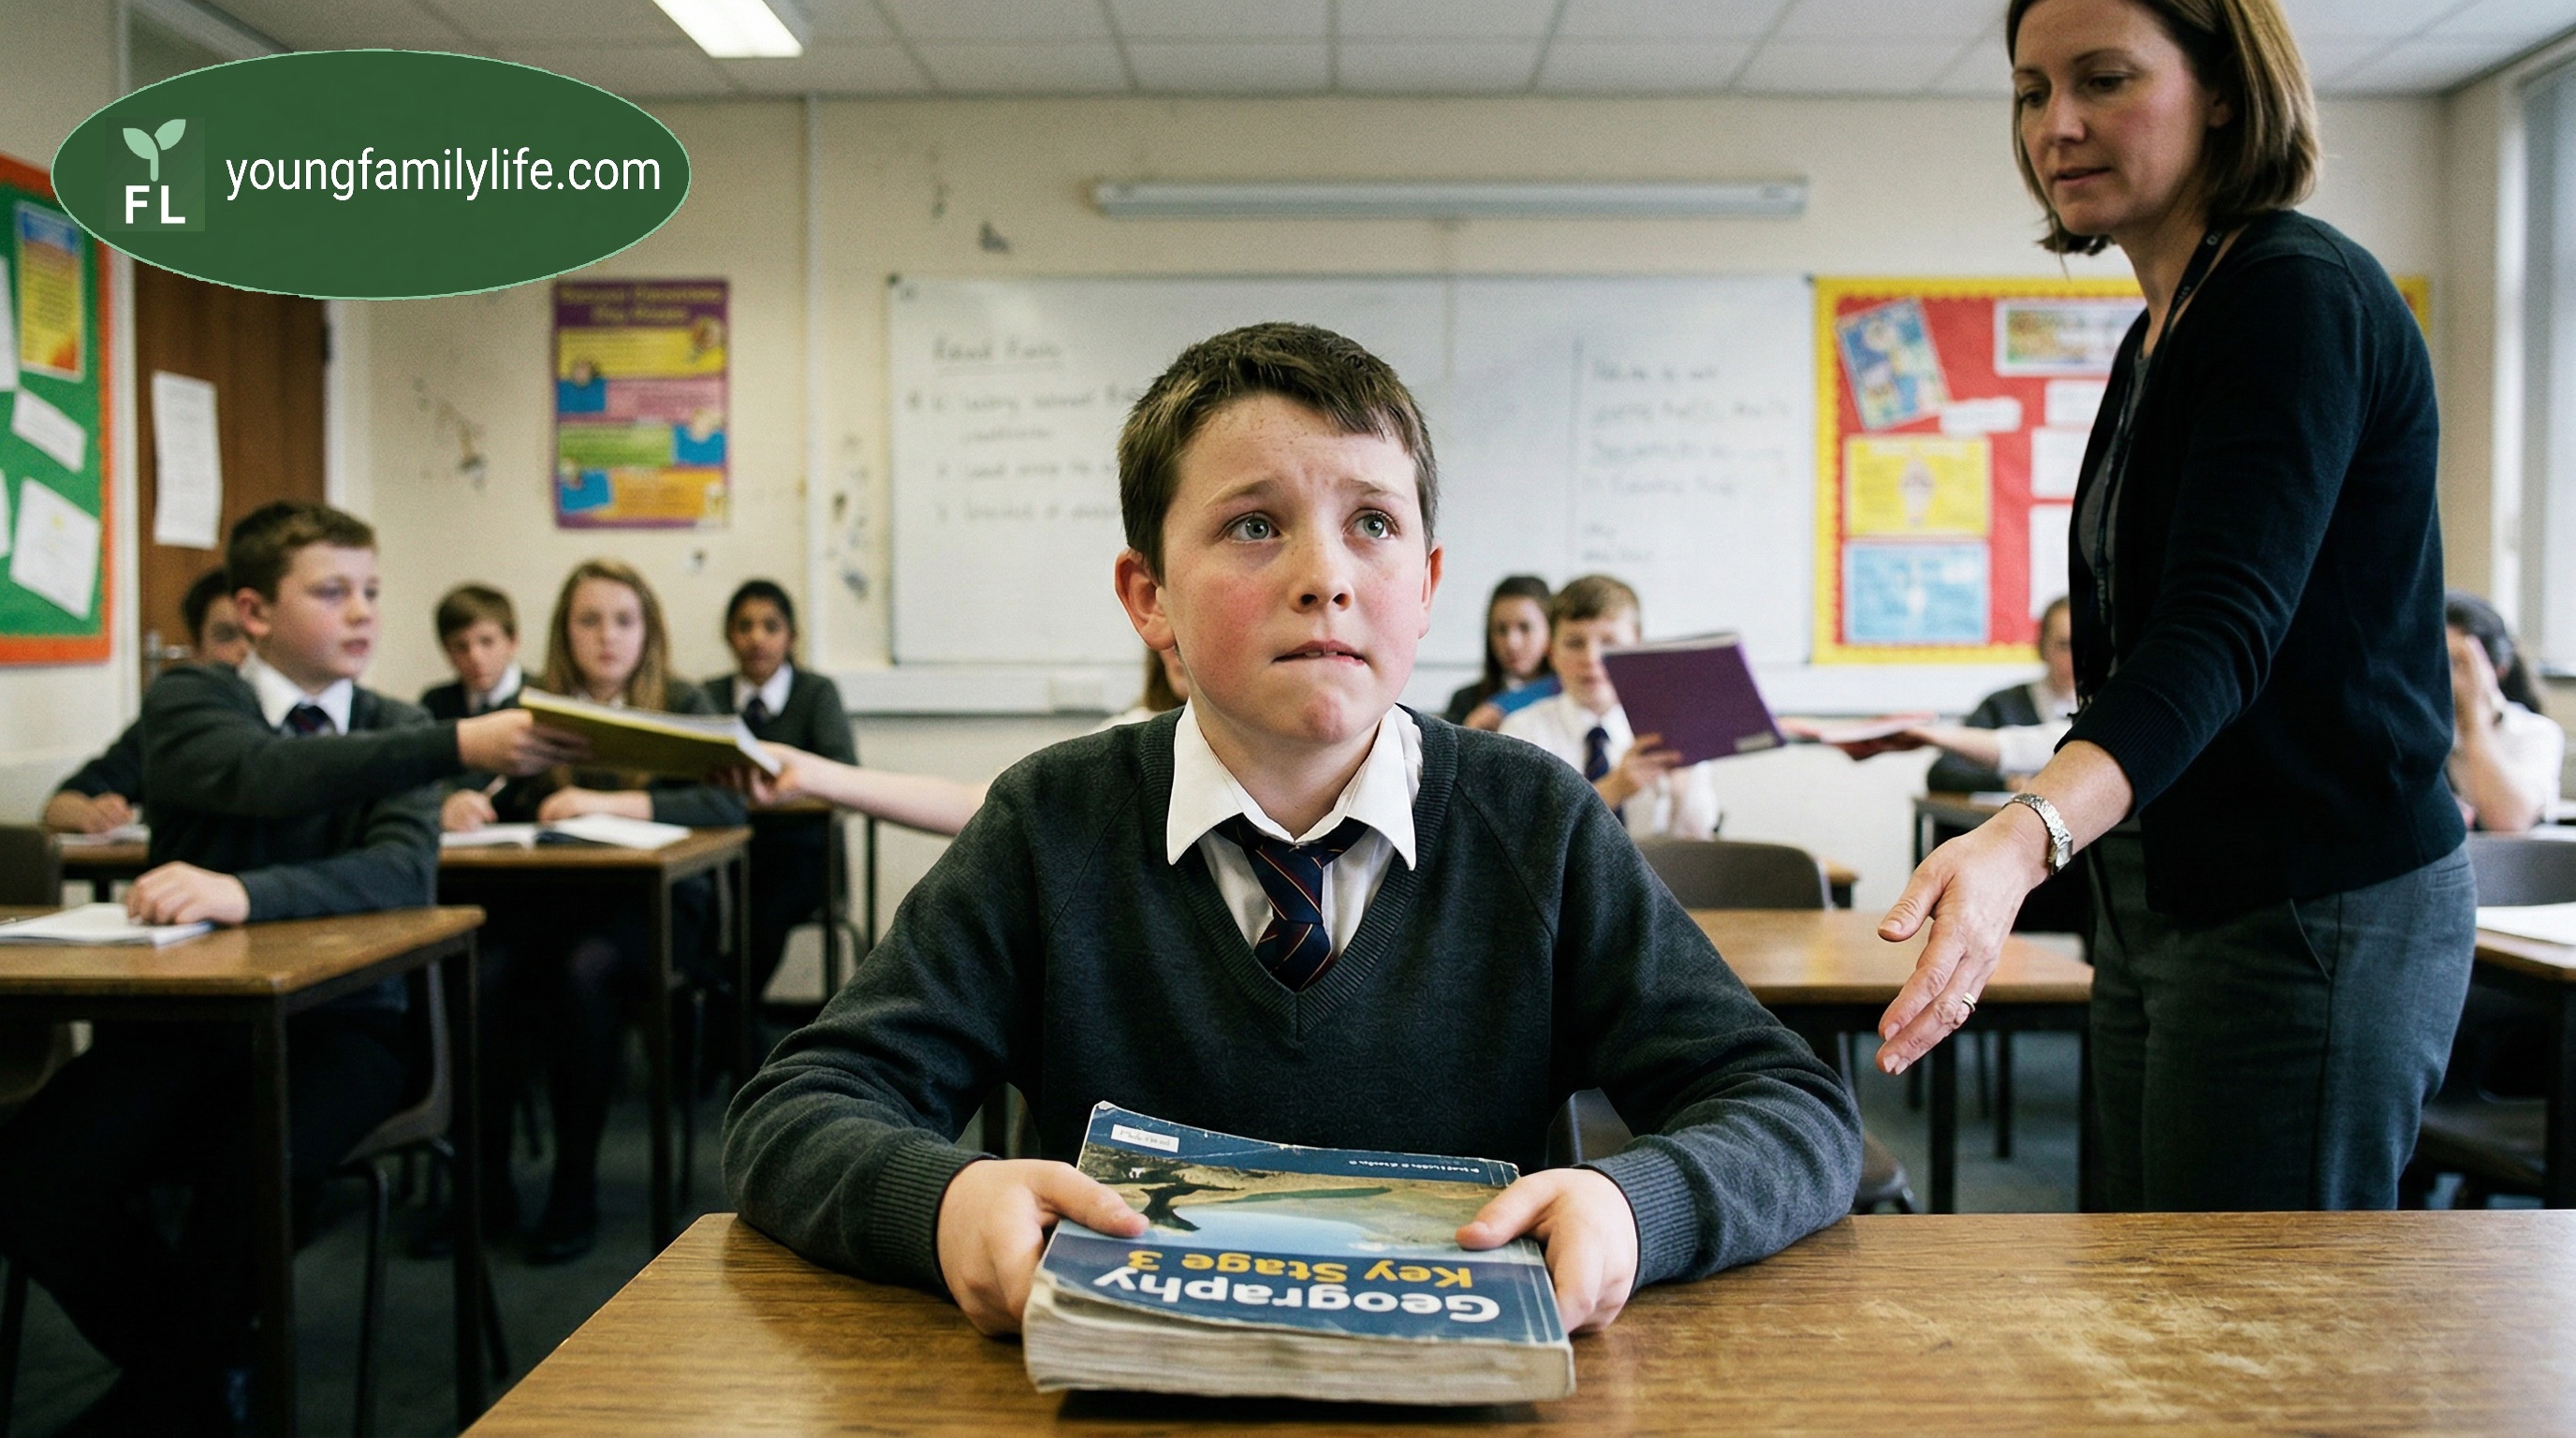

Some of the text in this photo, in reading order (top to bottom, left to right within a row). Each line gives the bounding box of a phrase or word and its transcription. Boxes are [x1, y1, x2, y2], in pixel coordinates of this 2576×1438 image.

[1127, 1250, 1473, 1289] Key Stage 3
[1092, 1266, 1501, 1324] Geography
